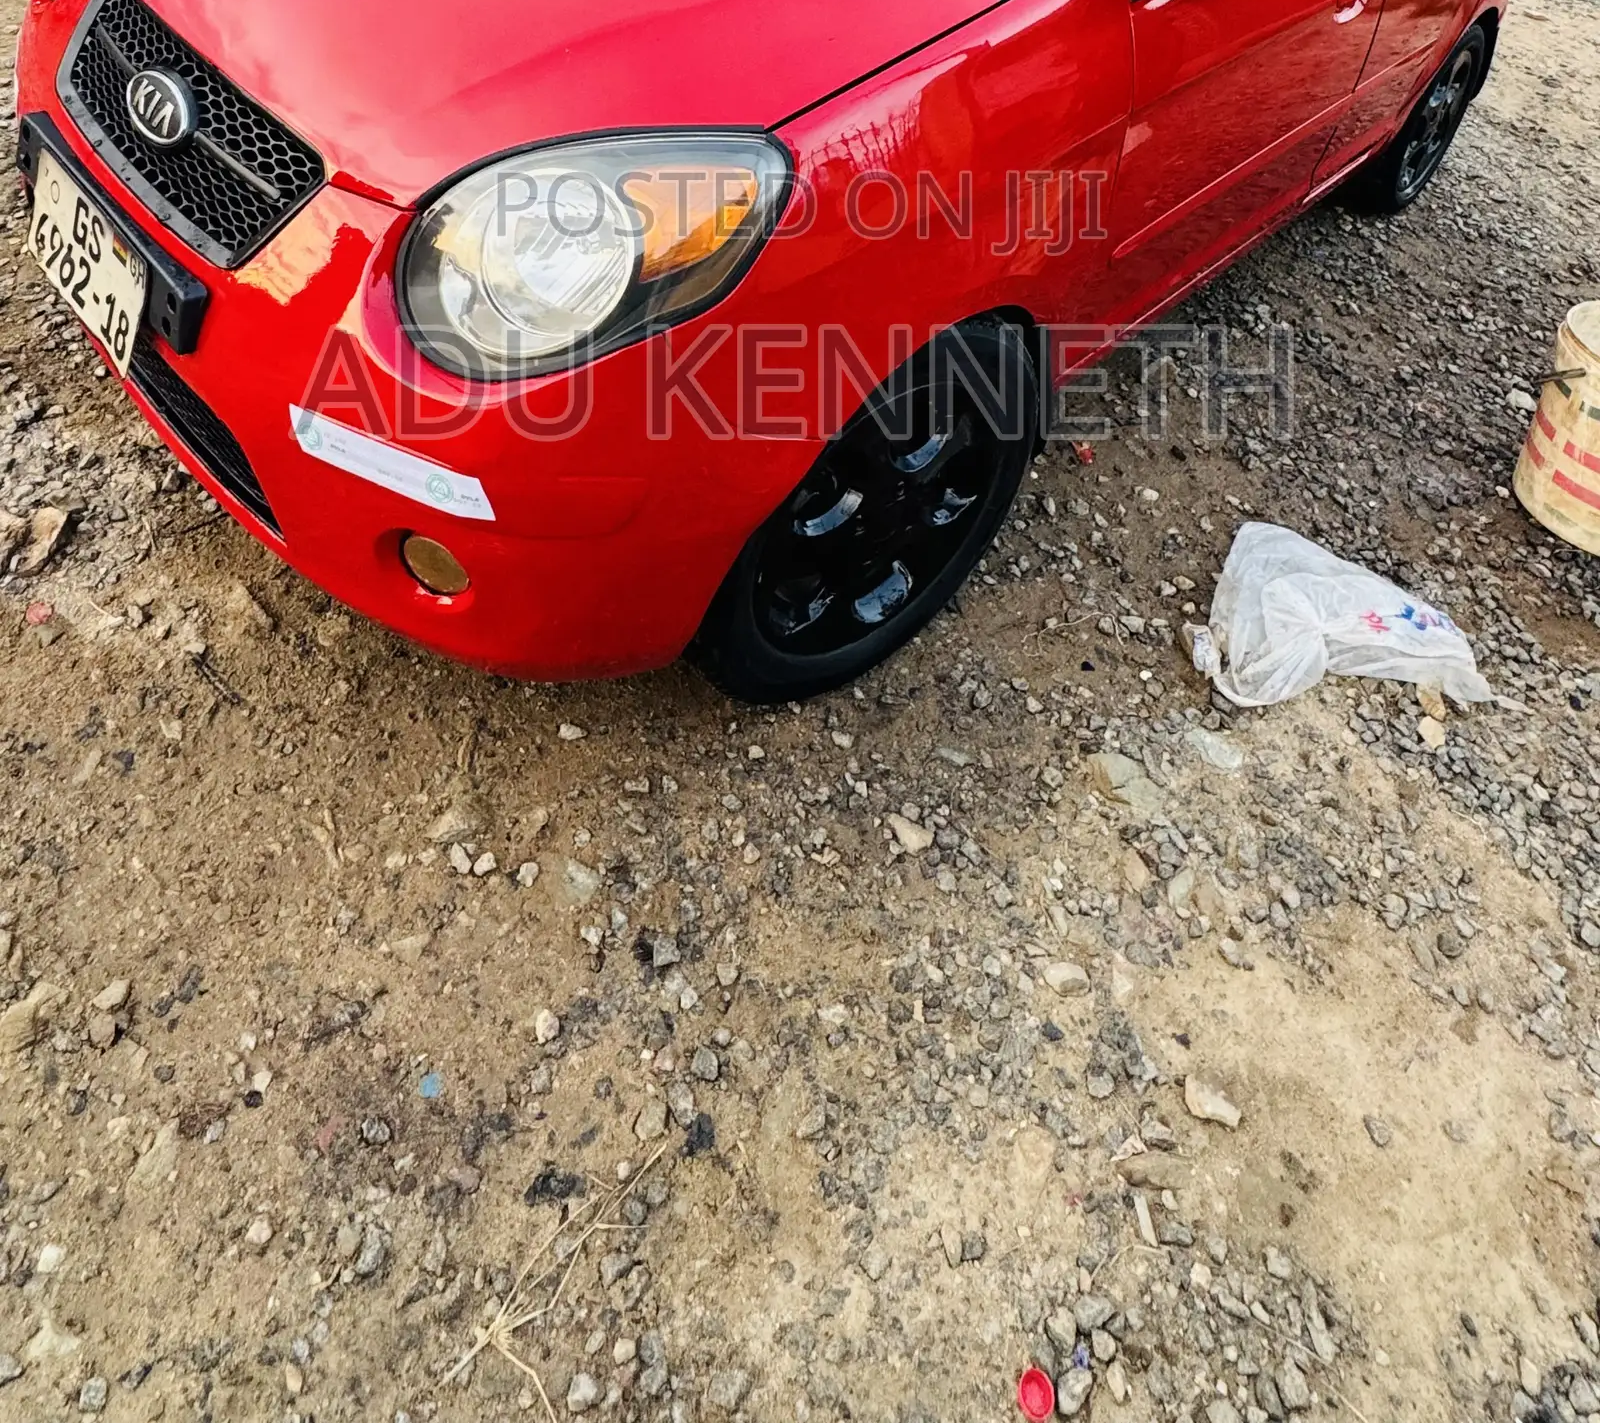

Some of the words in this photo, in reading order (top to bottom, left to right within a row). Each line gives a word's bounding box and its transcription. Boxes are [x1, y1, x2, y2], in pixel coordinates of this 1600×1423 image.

[132, 77, 176, 138] KIA
[72, 196, 105, 265] GS
[129, 249, 146, 291] GH
